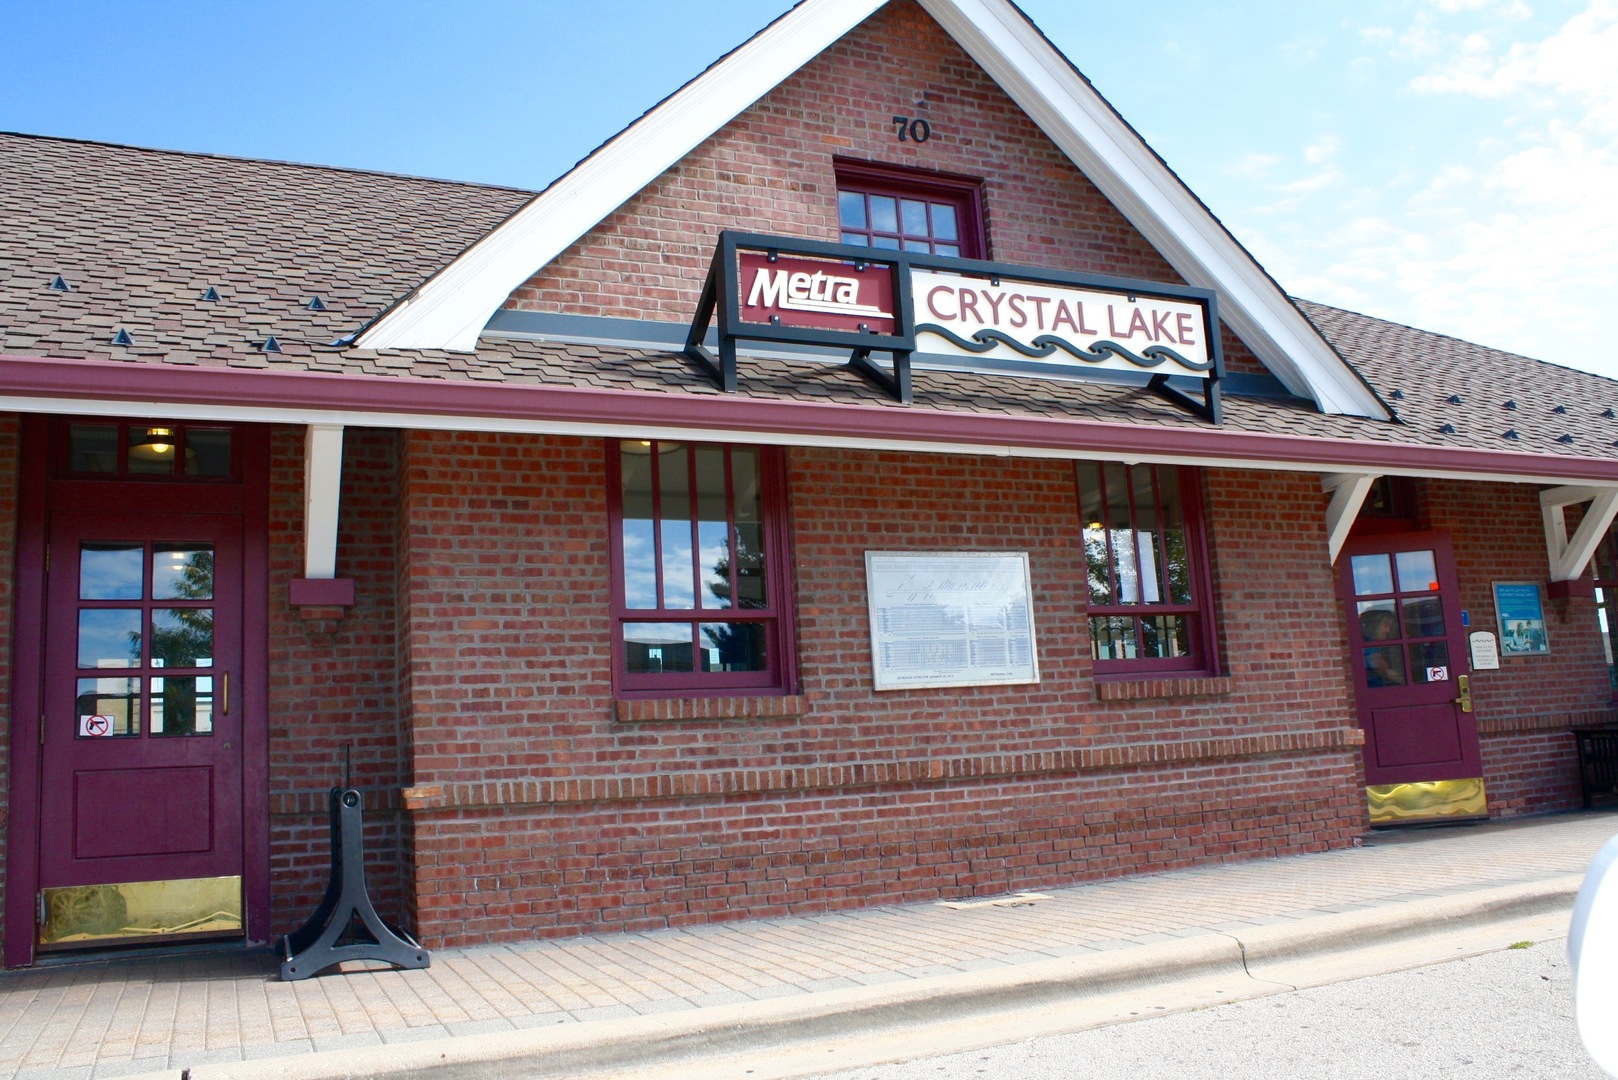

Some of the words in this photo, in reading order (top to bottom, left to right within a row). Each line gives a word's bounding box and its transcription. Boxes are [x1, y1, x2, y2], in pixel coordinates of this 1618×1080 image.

[892, 116, 930, 143] 70
[747, 267, 860, 309] Metra
[926, 285, 1098, 336] CRYSTAL
[1107, 304, 1196, 346] LAKE
